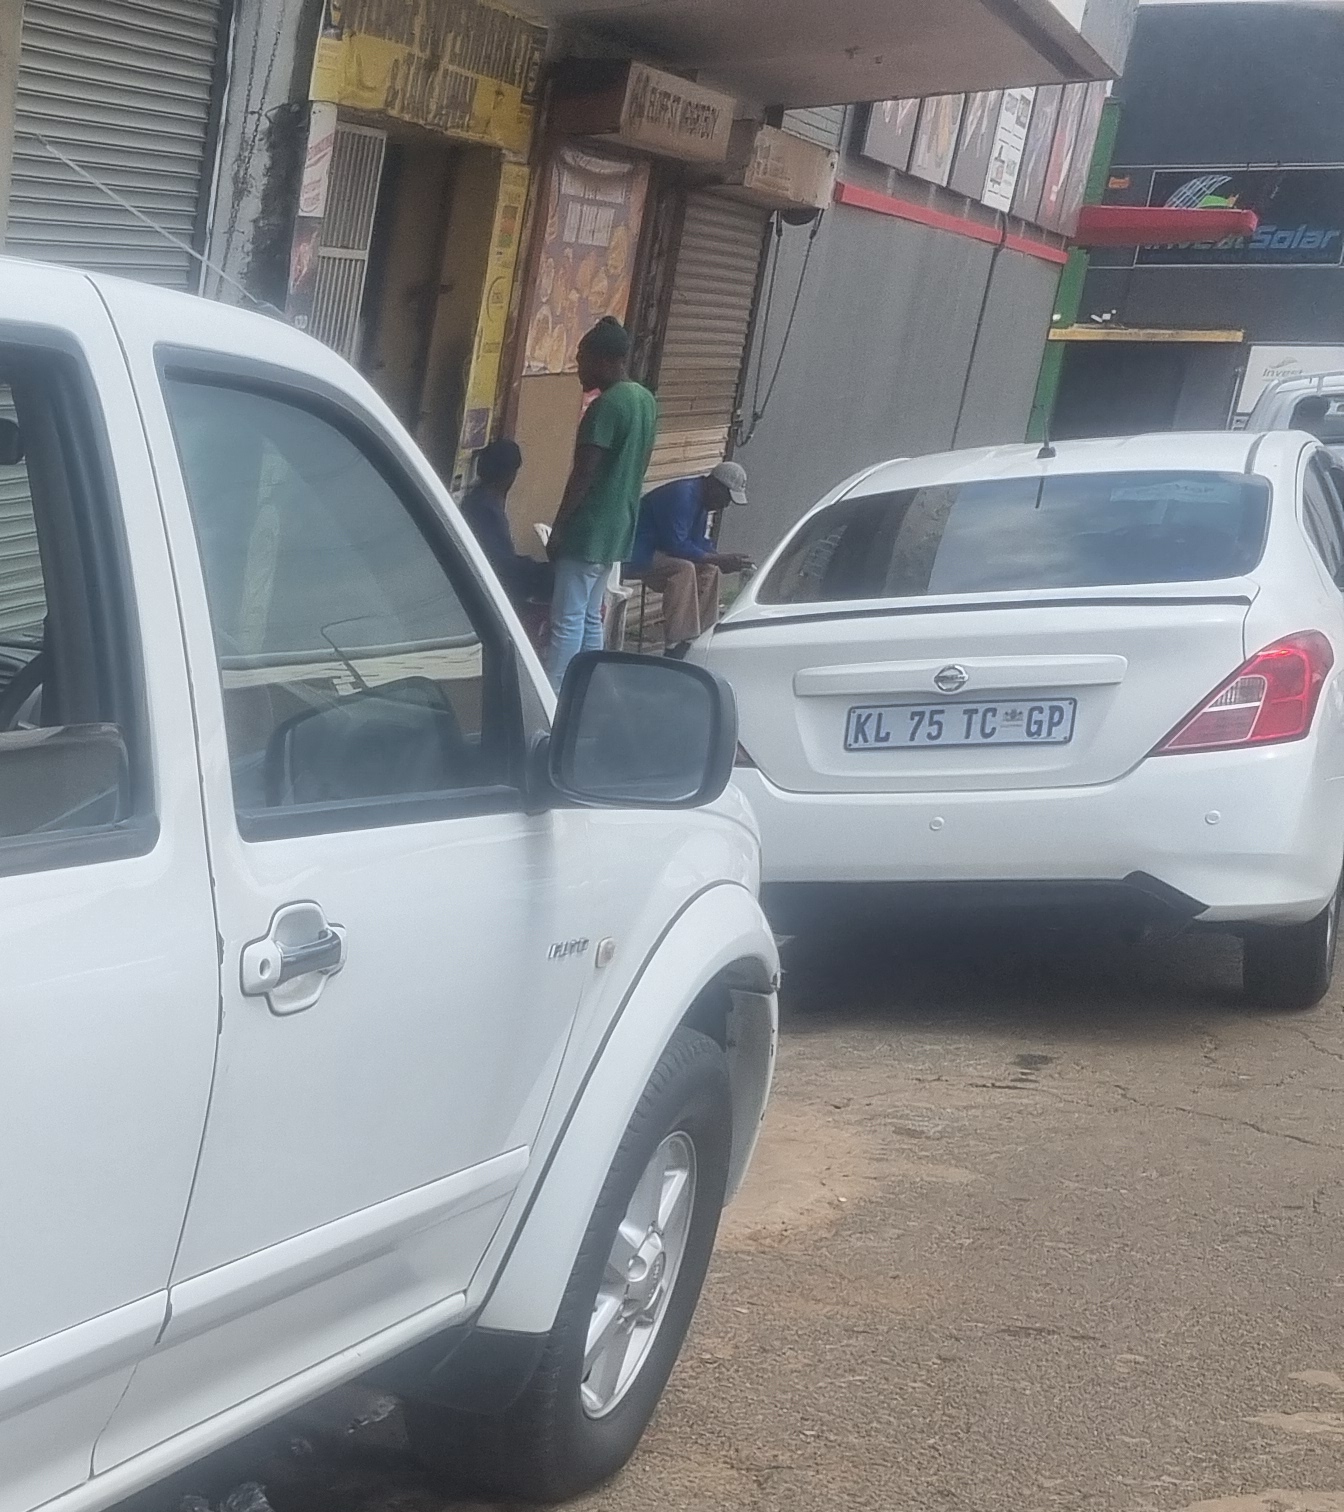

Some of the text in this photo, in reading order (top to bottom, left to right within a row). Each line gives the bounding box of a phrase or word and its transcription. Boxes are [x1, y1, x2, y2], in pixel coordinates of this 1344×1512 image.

[853, 705, 1065, 744] KL 75 TC GP
